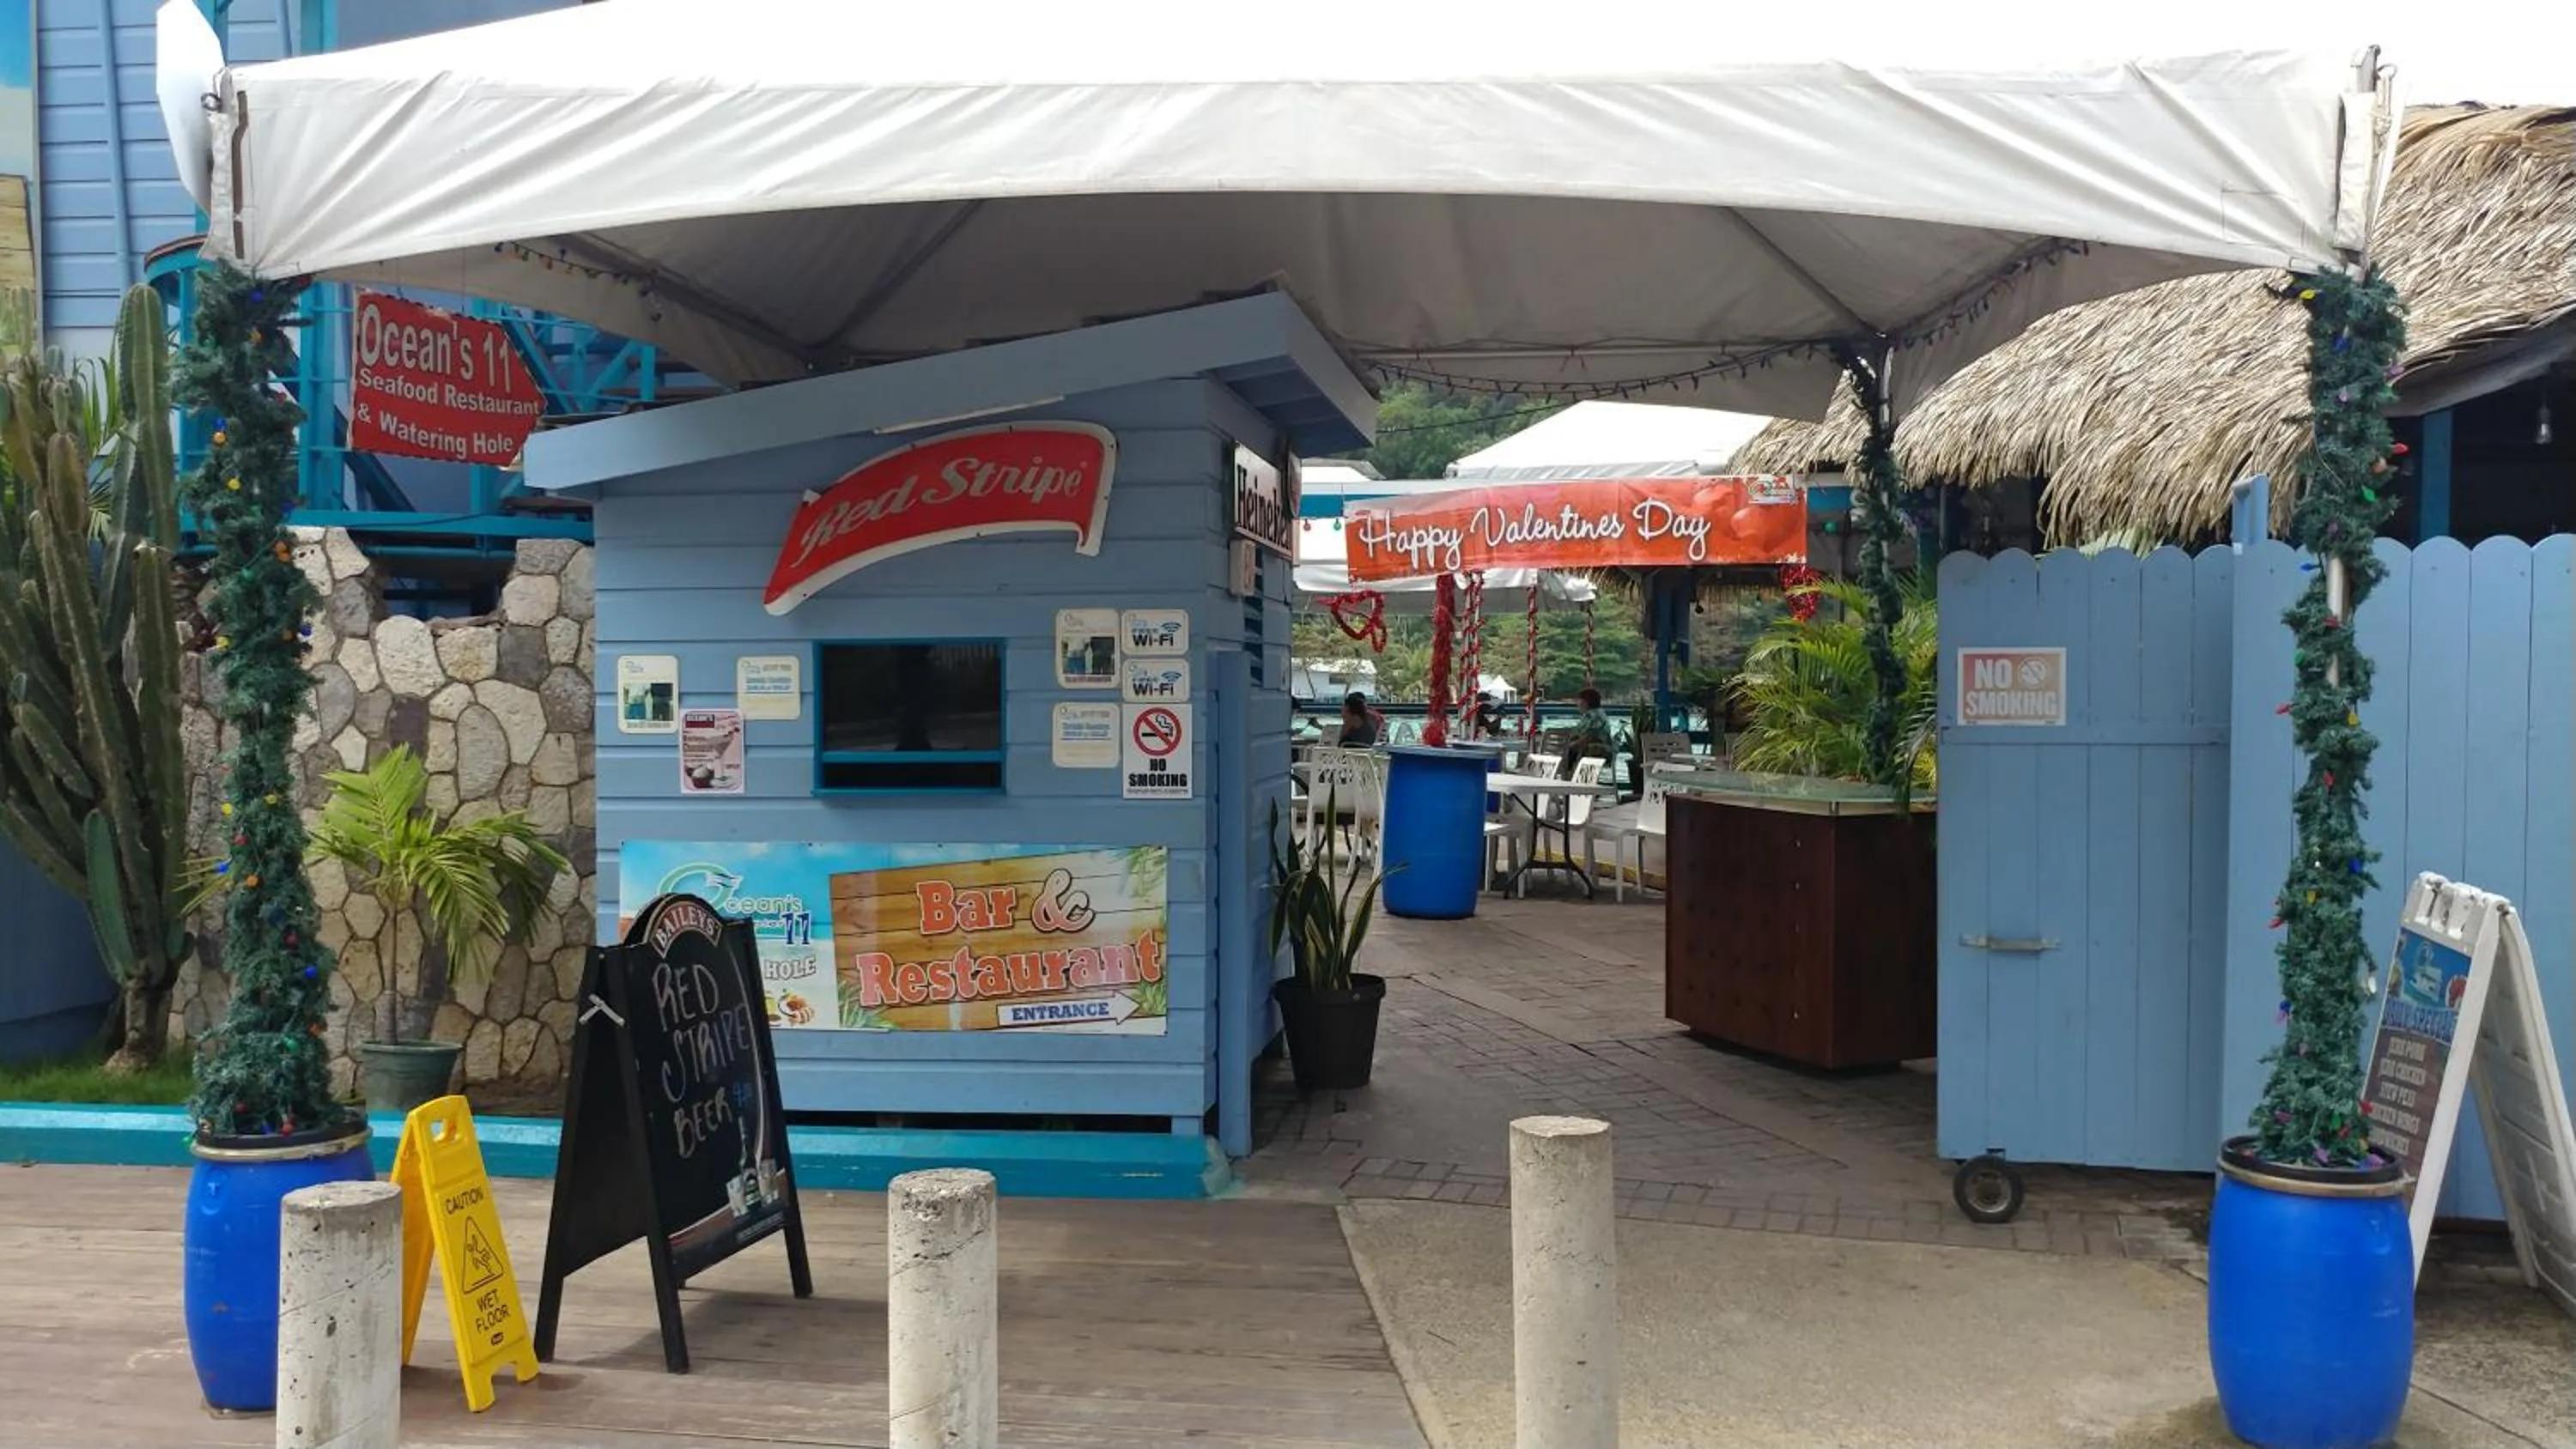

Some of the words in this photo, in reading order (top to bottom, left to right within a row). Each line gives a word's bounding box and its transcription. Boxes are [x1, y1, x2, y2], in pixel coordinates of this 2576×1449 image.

[360, 304, 473, 380] Ocean's
[483, 331, 511, 393] 11
[360, 368, 438, 404] Seafood
[445, 384, 539, 415] Restaurant
[357, 403, 372, 424] &
[380, 410, 466, 459] Watering
[473, 433, 513, 454] Hole
[791, 476, 918, 567] Red
[922, 456, 1082, 504] Stripe
[1236, 464, 1291, 550] Heineke
[1358, 507, 1462, 569] Happy
[1469, 503, 1625, 547] Valentines
[1632, 496, 1711, 561] Day
[1133, 634, 1174, 646] Wi-Fi
[1133, 682, 1174, 696] Wi-Fi
[1974, 658, 2013, 689] NO
[1965, 690, 2057, 717] SMOKING
[1128, 773, 1188, 787] SMOKING
[1150, 758, 1167, 772] NO
[915, 879, 1019, 936] Bar
[1031, 867, 1097, 933] &
[655, 906, 715, 949] BAILEYS
[780, 910, 811, 946] 11
[763, 955, 817, 981] HOLE
[856, 929, 1163, 1007] Restaurant
[652, 962, 719, 1031] RED
[1011, 1001, 1109, 1022] ENTRANCE
[661, 1002, 750, 1103] STRIPE
[673, 1086, 732, 1159] BEER
[445, 1186, 483, 1216] CAUTION
[475, 1304, 511, 1334] FLOOR
[477, 1288, 500, 1313] WET
